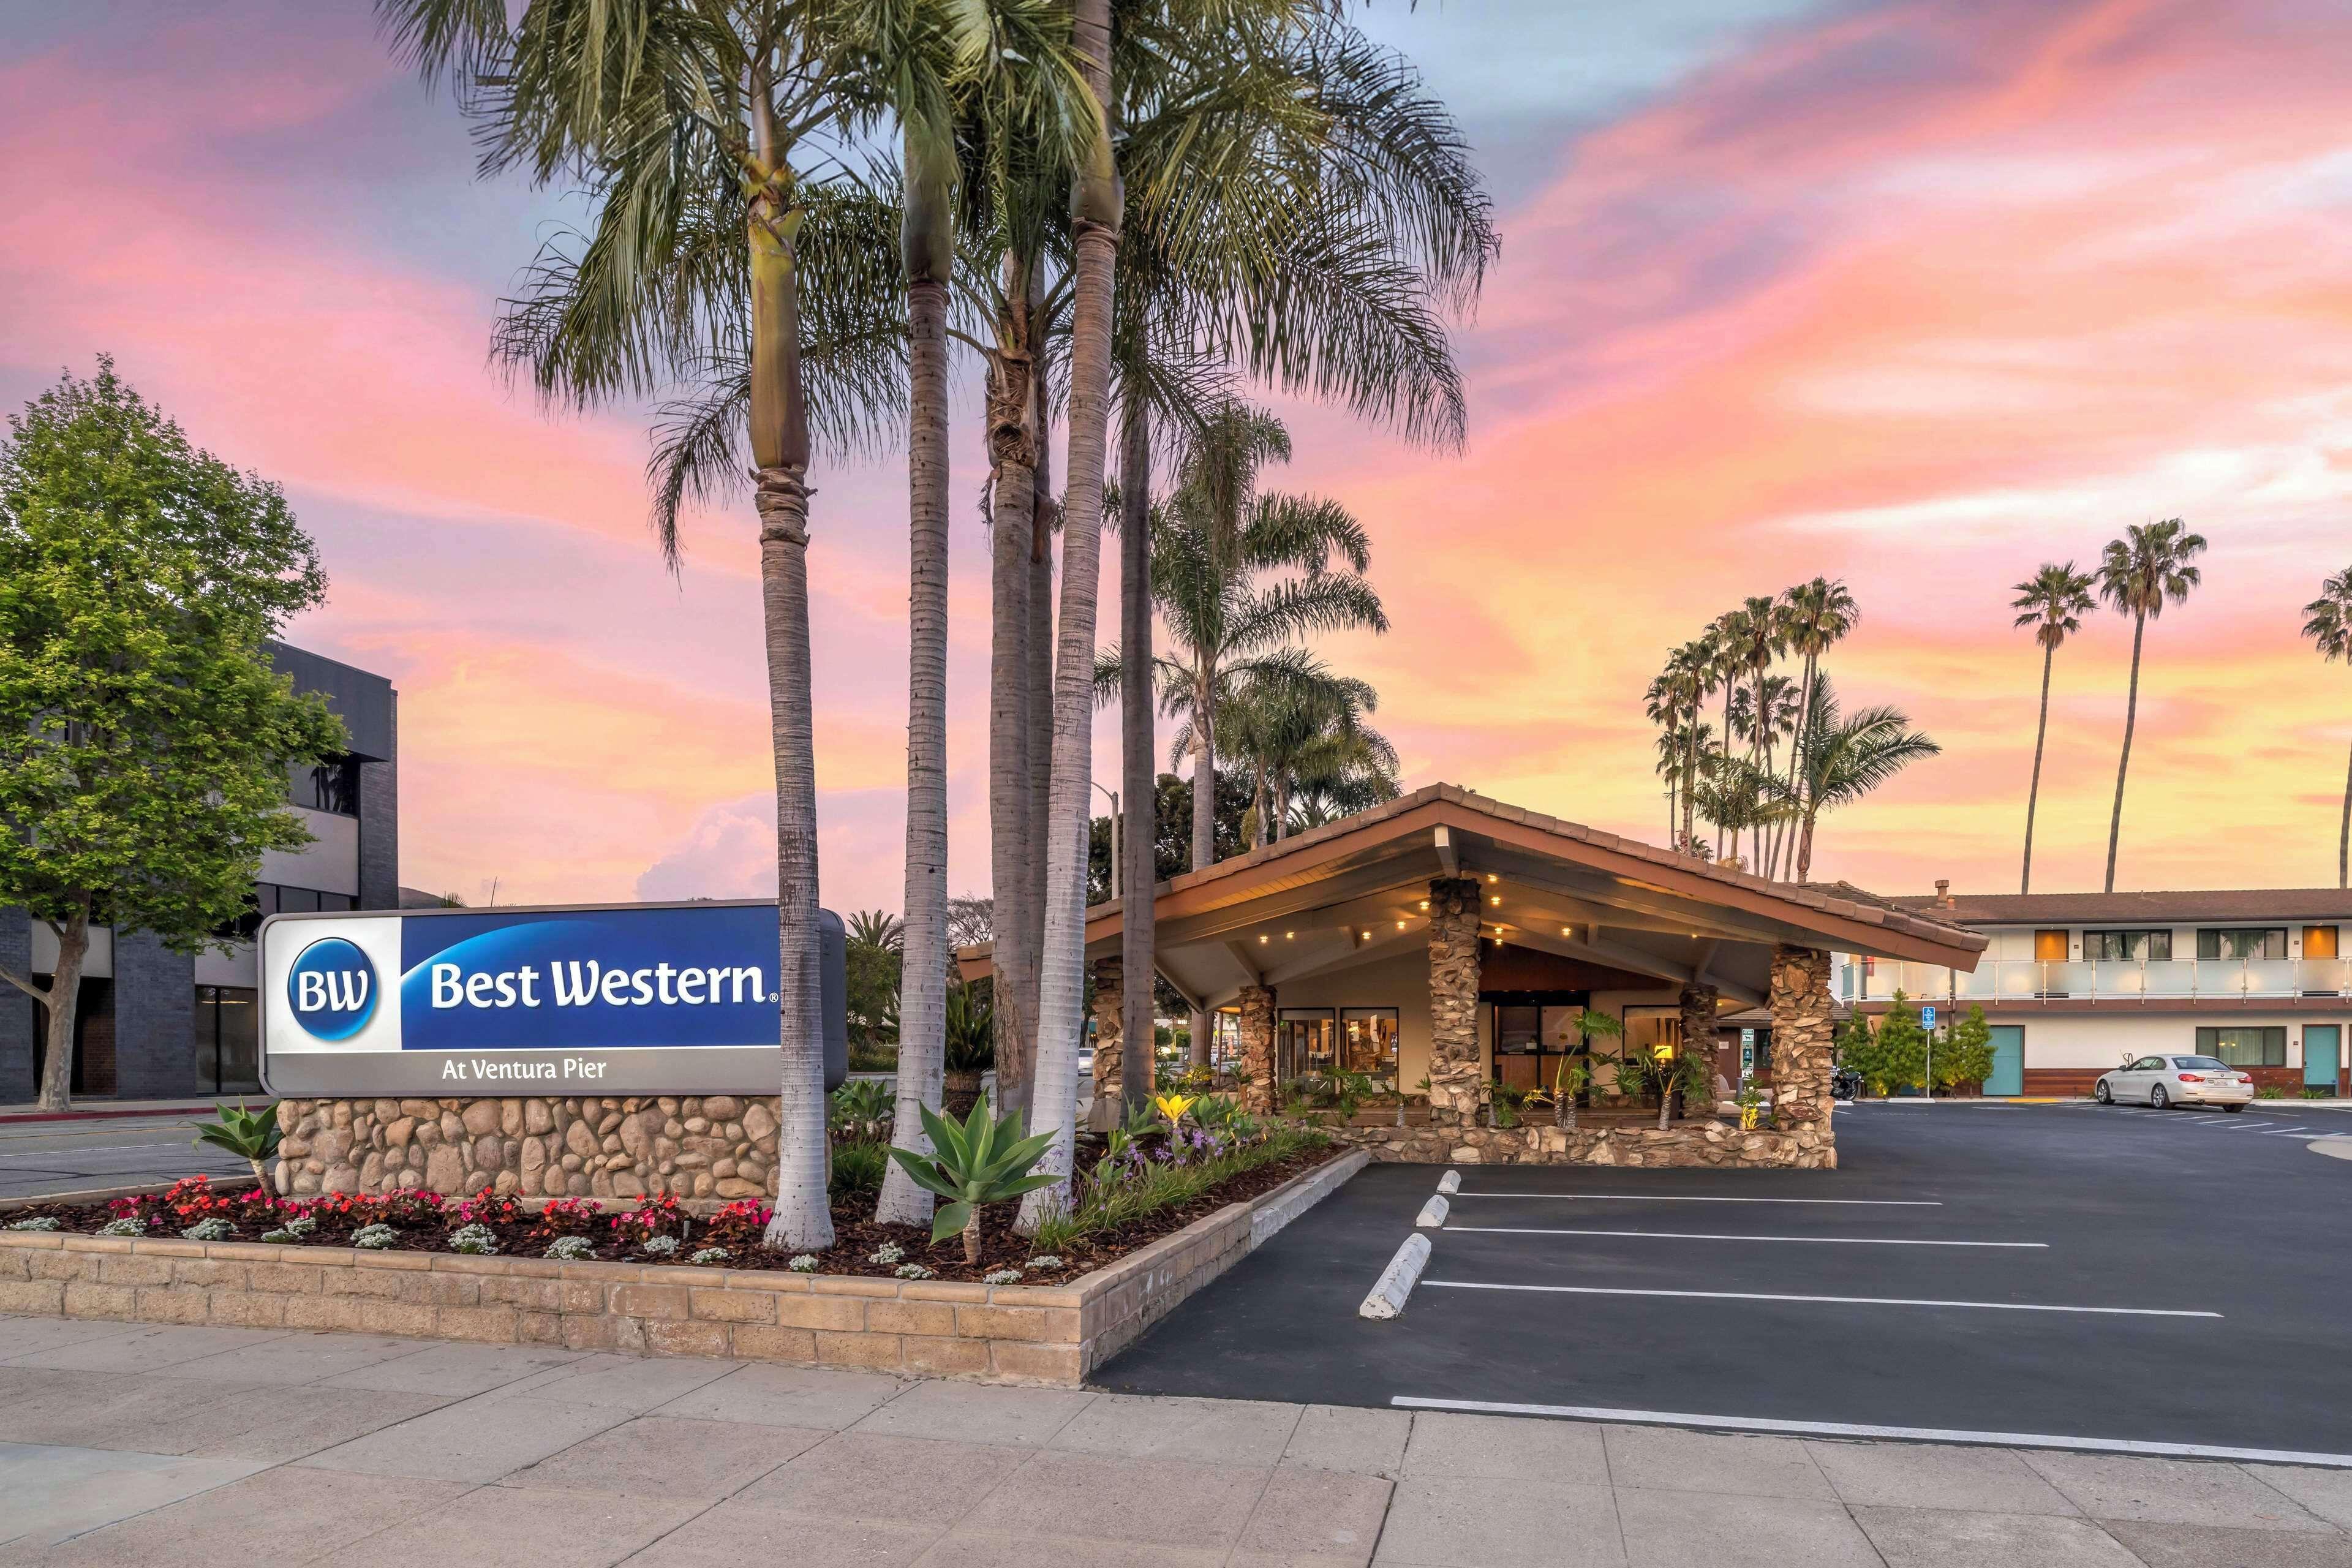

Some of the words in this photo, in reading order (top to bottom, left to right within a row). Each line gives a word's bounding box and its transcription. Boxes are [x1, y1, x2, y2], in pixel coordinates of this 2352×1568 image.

[299, 970, 368, 1011] BW
[432, 963, 540, 1008] Best
[442, 1060, 467, 1079] At
[471, 1059, 557, 1079] Ventura
[564, 1057, 606, 1078] Pier
